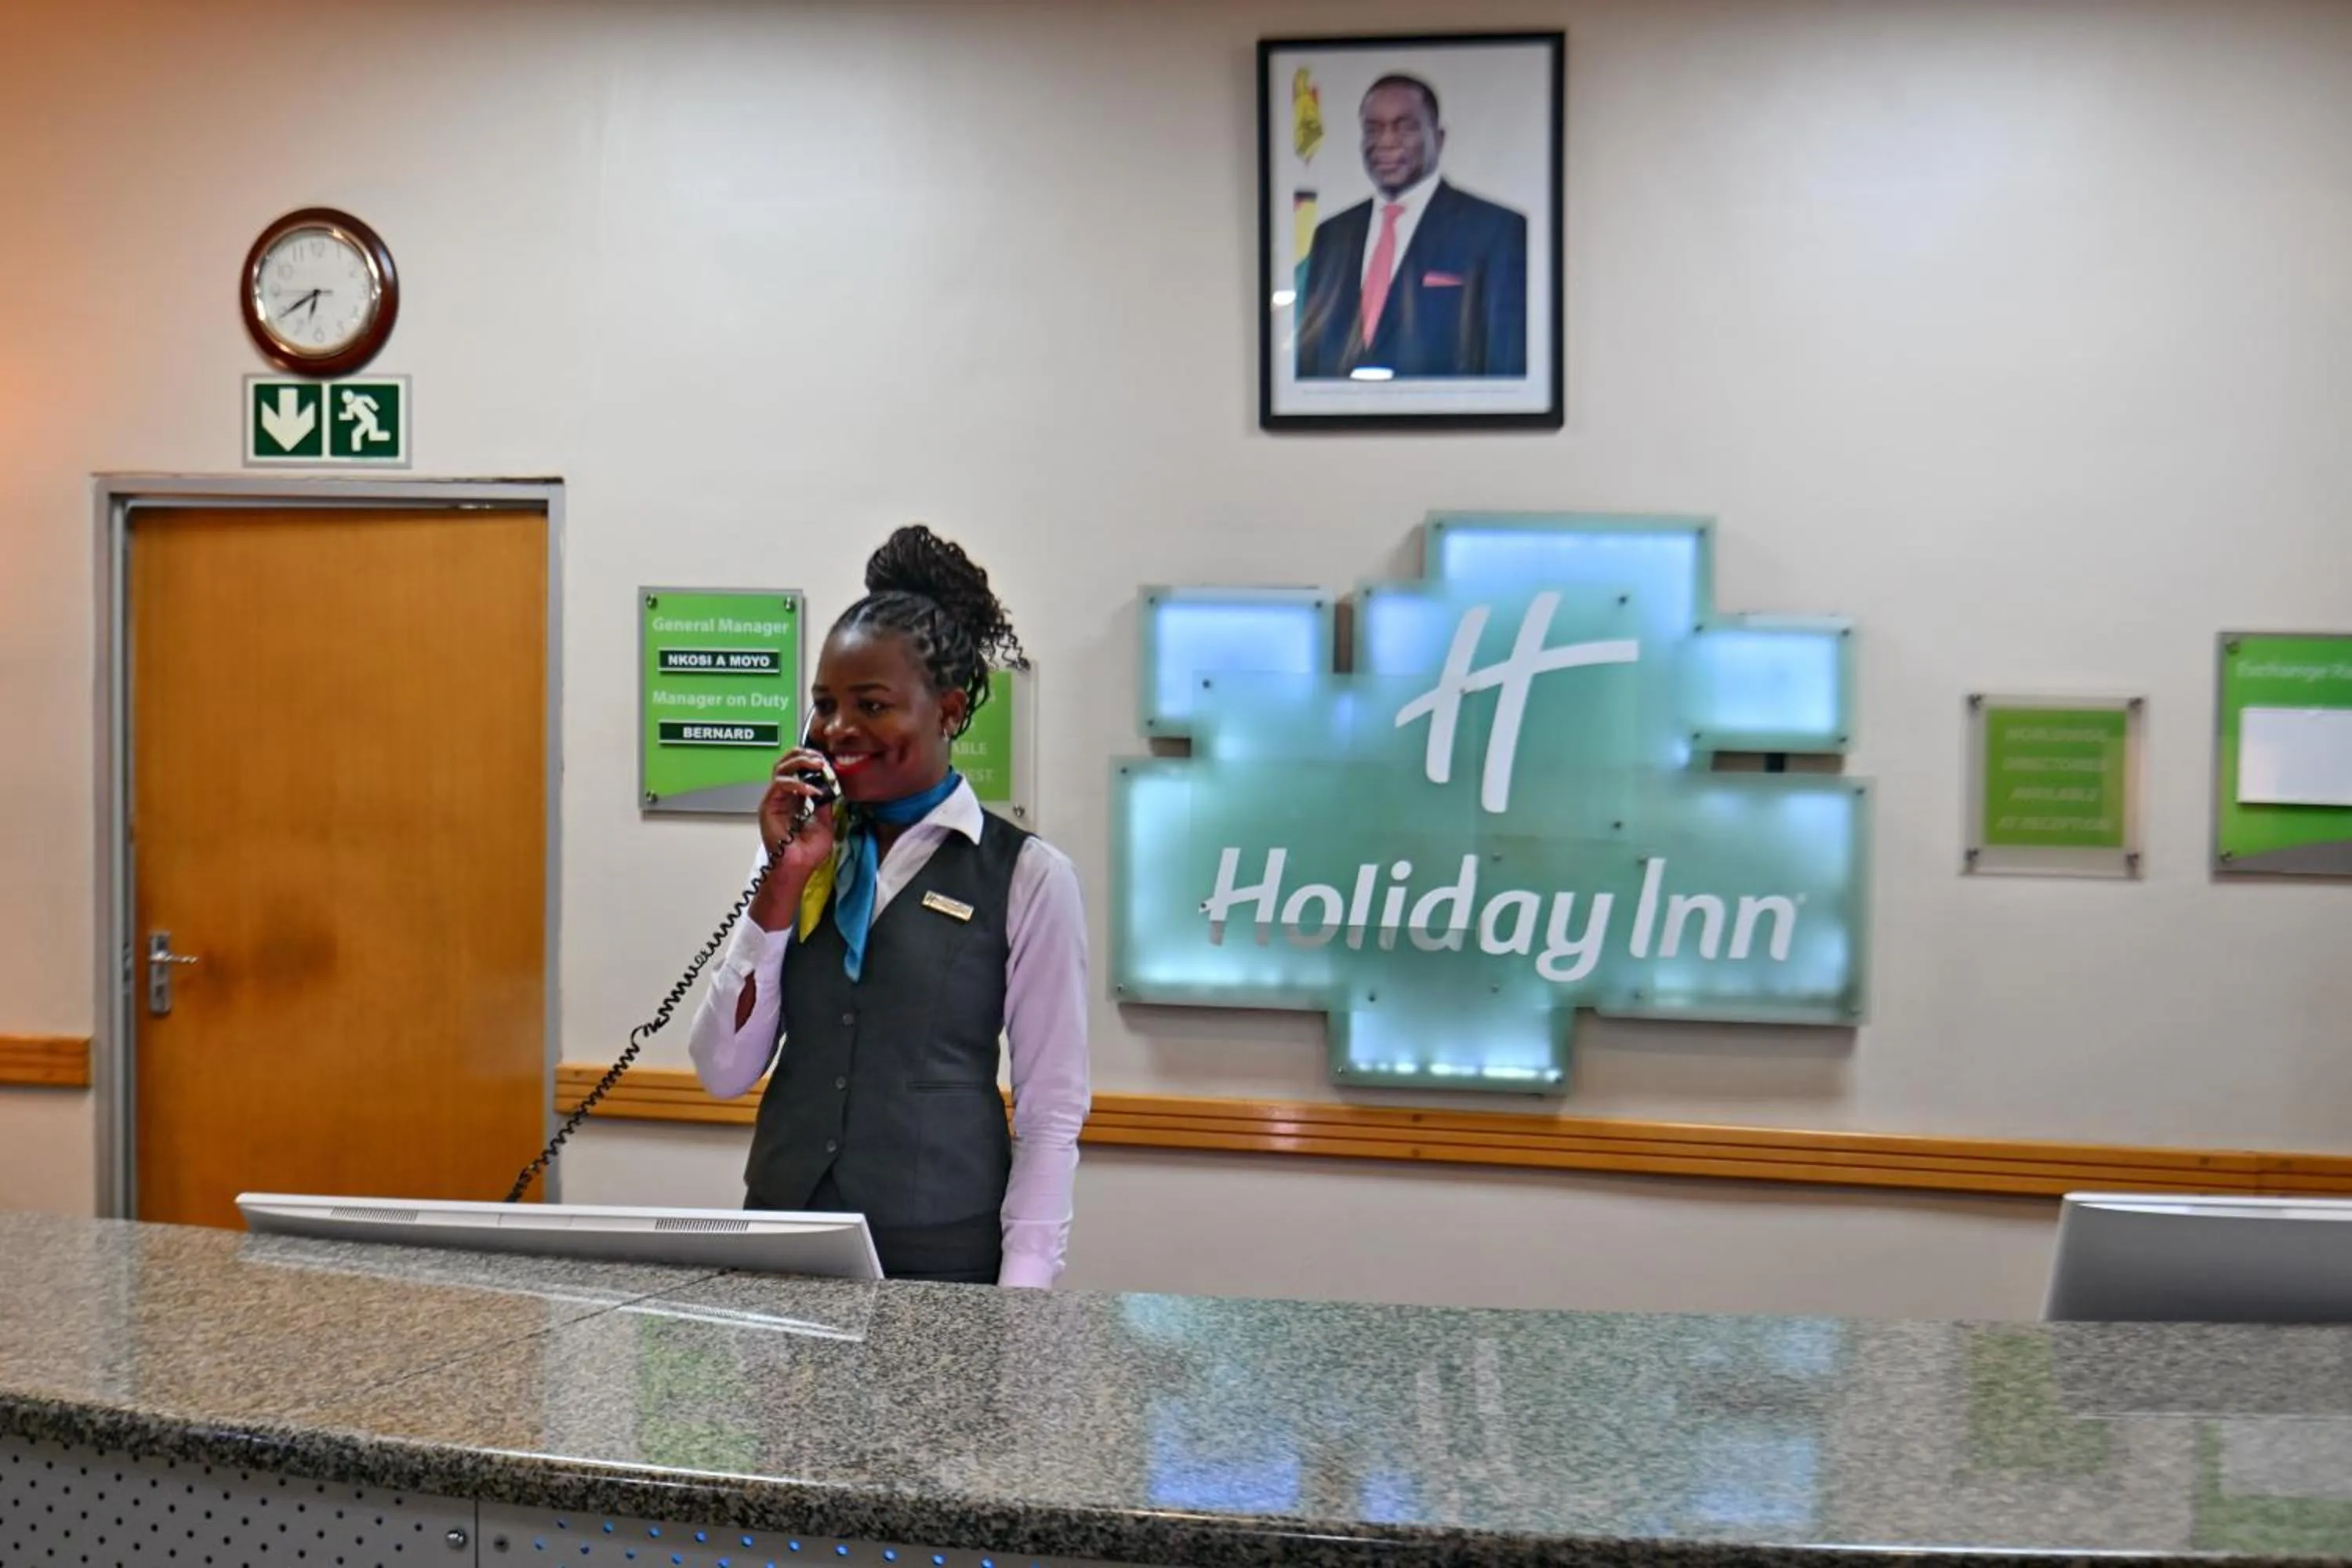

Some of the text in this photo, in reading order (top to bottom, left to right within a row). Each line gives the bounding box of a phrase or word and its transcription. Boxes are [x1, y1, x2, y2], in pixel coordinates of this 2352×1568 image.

[652, 617, 789, 637] General Manager
[668, 654, 771, 667] NKOSI A MOYO
[652, 690, 789, 710] Manager on Duty
[683, 726, 755, 740] BERNARD
[1199, 847, 1798, 982] Holiday Inn
